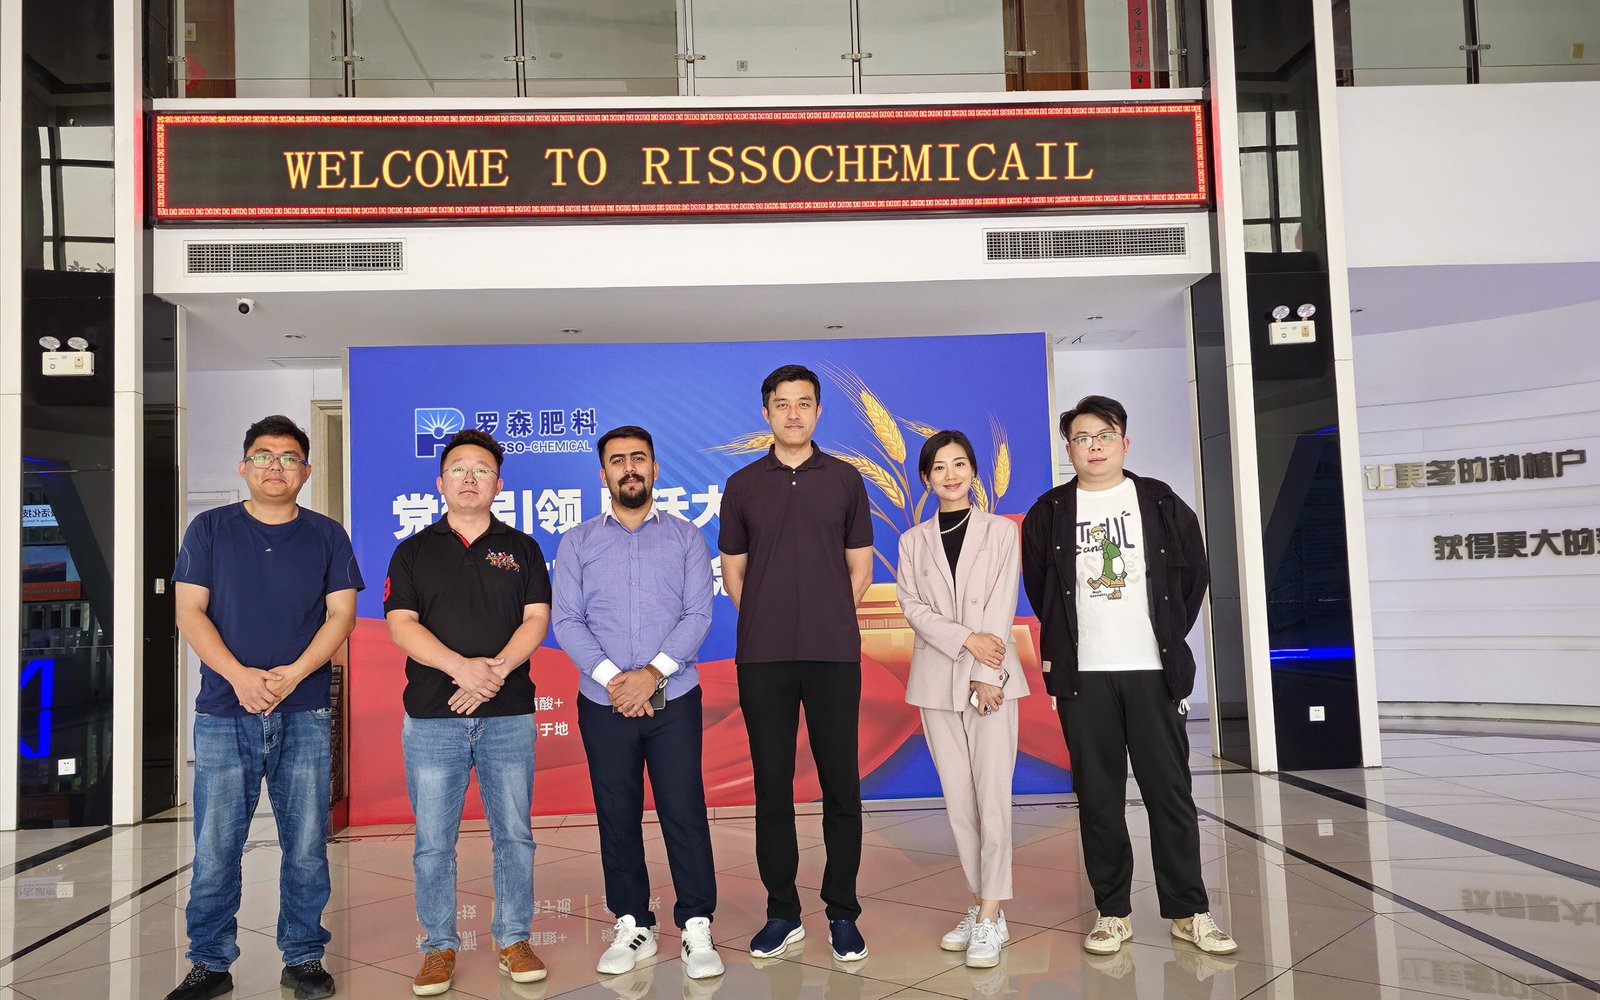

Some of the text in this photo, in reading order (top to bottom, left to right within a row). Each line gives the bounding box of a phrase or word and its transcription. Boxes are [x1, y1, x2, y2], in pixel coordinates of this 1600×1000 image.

[284, 141, 1094, 189] WELCOME TO RISSOCHEMICAIL
[475, 408, 597, 437] 罗森肥料
[499, 440, 592, 454] SSO-CHEMICAL
[1365, 449, 1587, 490] 让更多的种植户
[393, 485, 723, 540] 党引领 沃大
[1434, 528, 1600, 560] 获得更大的
[536, 721, 569, 737] 于地
